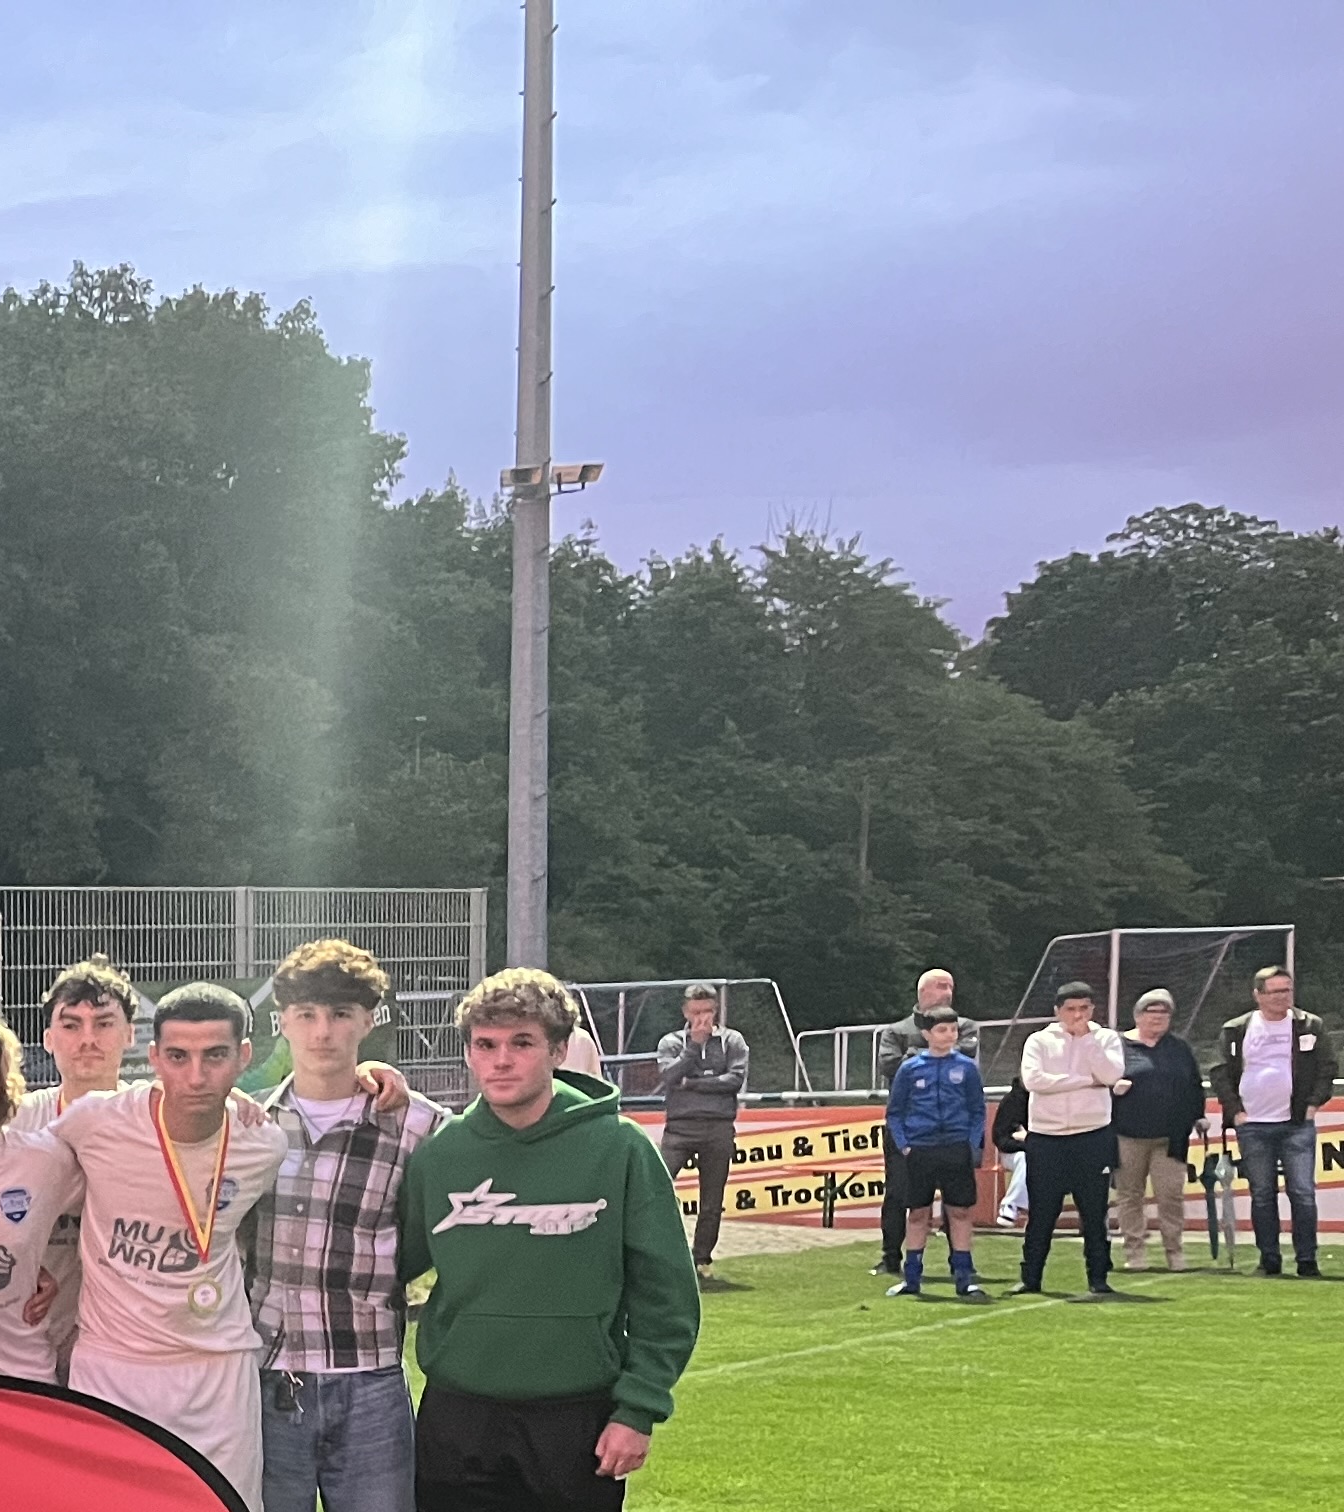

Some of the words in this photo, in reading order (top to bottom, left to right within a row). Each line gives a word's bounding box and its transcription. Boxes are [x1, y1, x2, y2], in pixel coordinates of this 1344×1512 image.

[792, 1136, 813, 1157] &
[821, 1124, 884, 1154] Tief
[735, 1189, 756, 1211] &
[113, 1217, 165, 1244] MU
[108, 1238, 156, 1270] WA
